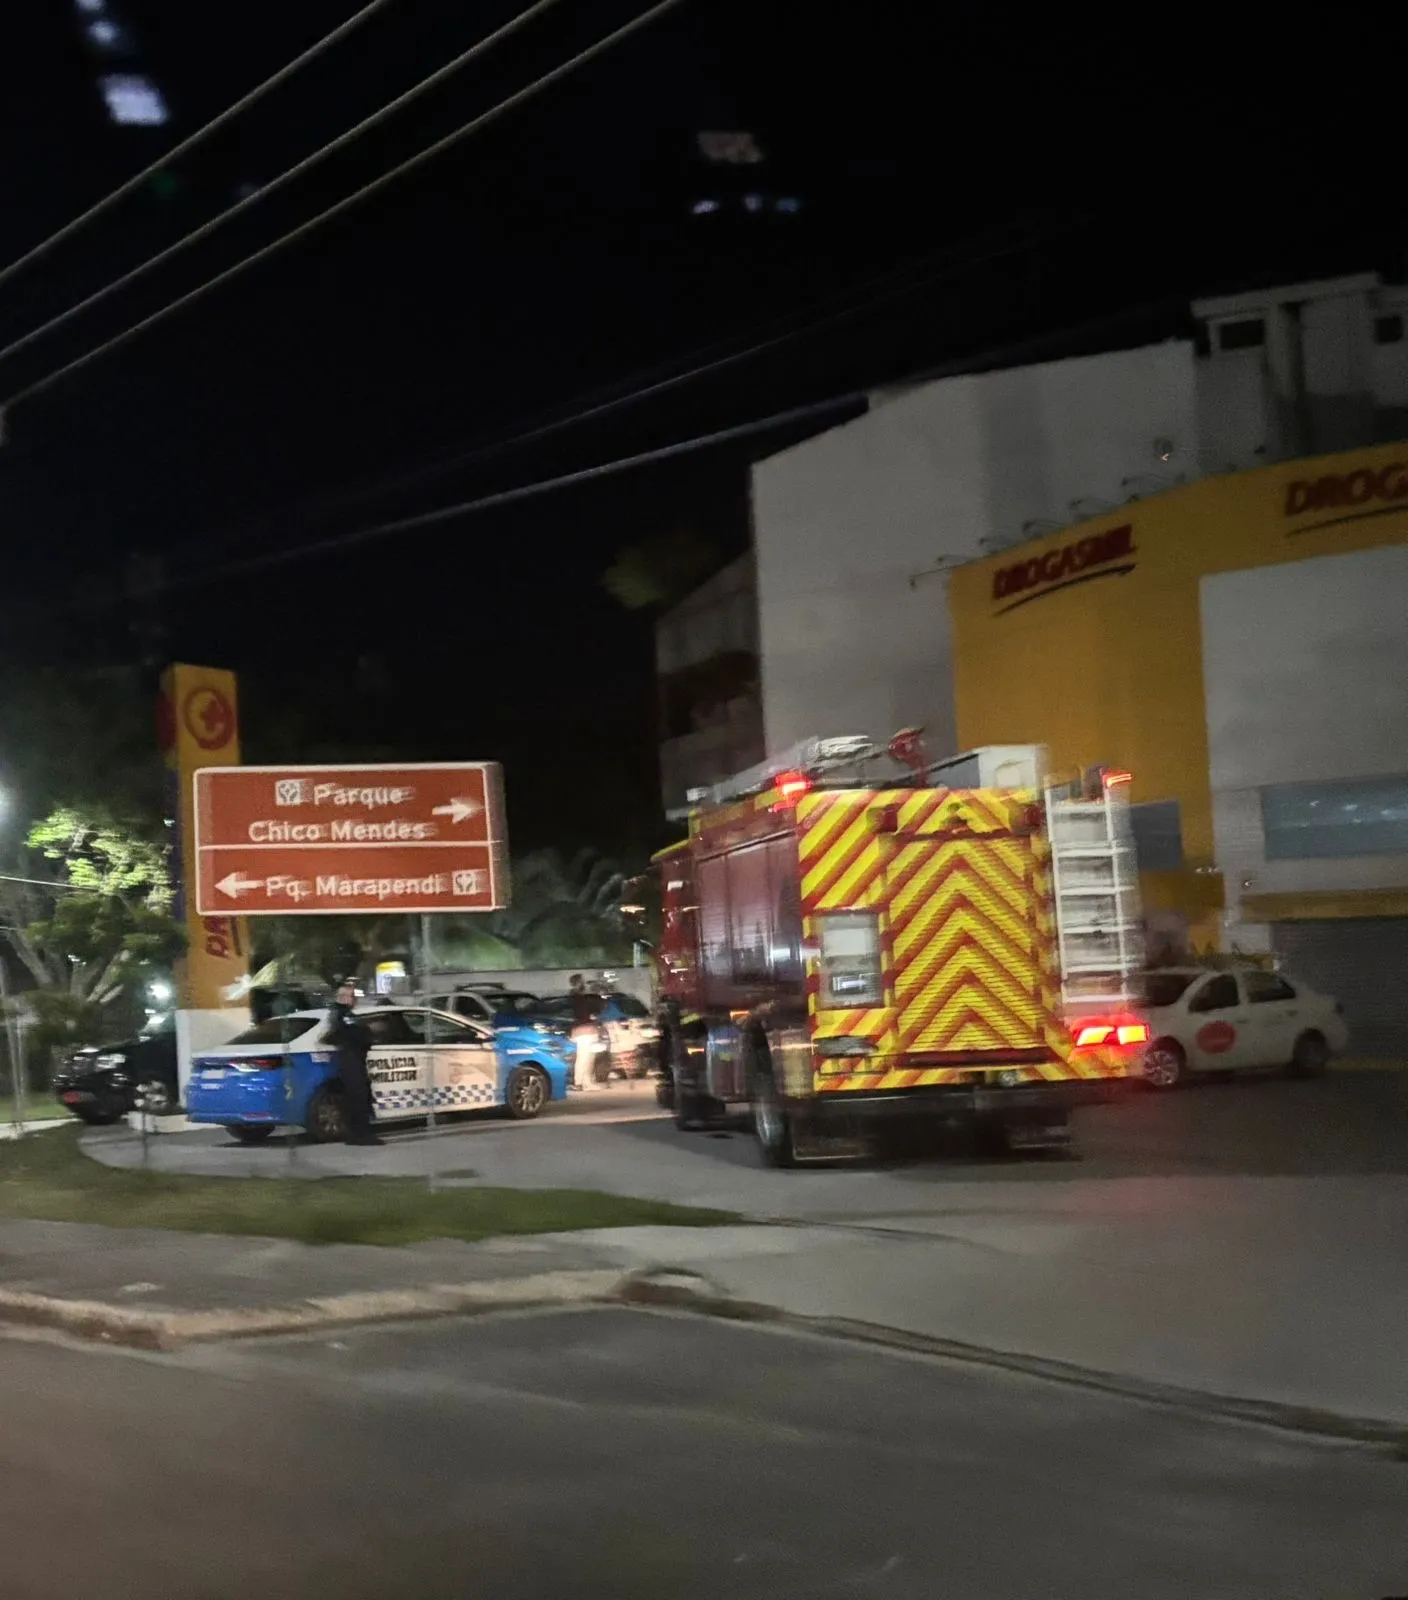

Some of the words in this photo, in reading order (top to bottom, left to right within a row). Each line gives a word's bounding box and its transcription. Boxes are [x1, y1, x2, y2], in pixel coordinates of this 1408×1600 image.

[314, 783, 405, 810] Parque
[249, 820, 321, 842] Chico
[331, 820, 429, 841] Mendes
[266, 876, 307, 902] Pq.
[316, 875, 442, 900] Marapendi
